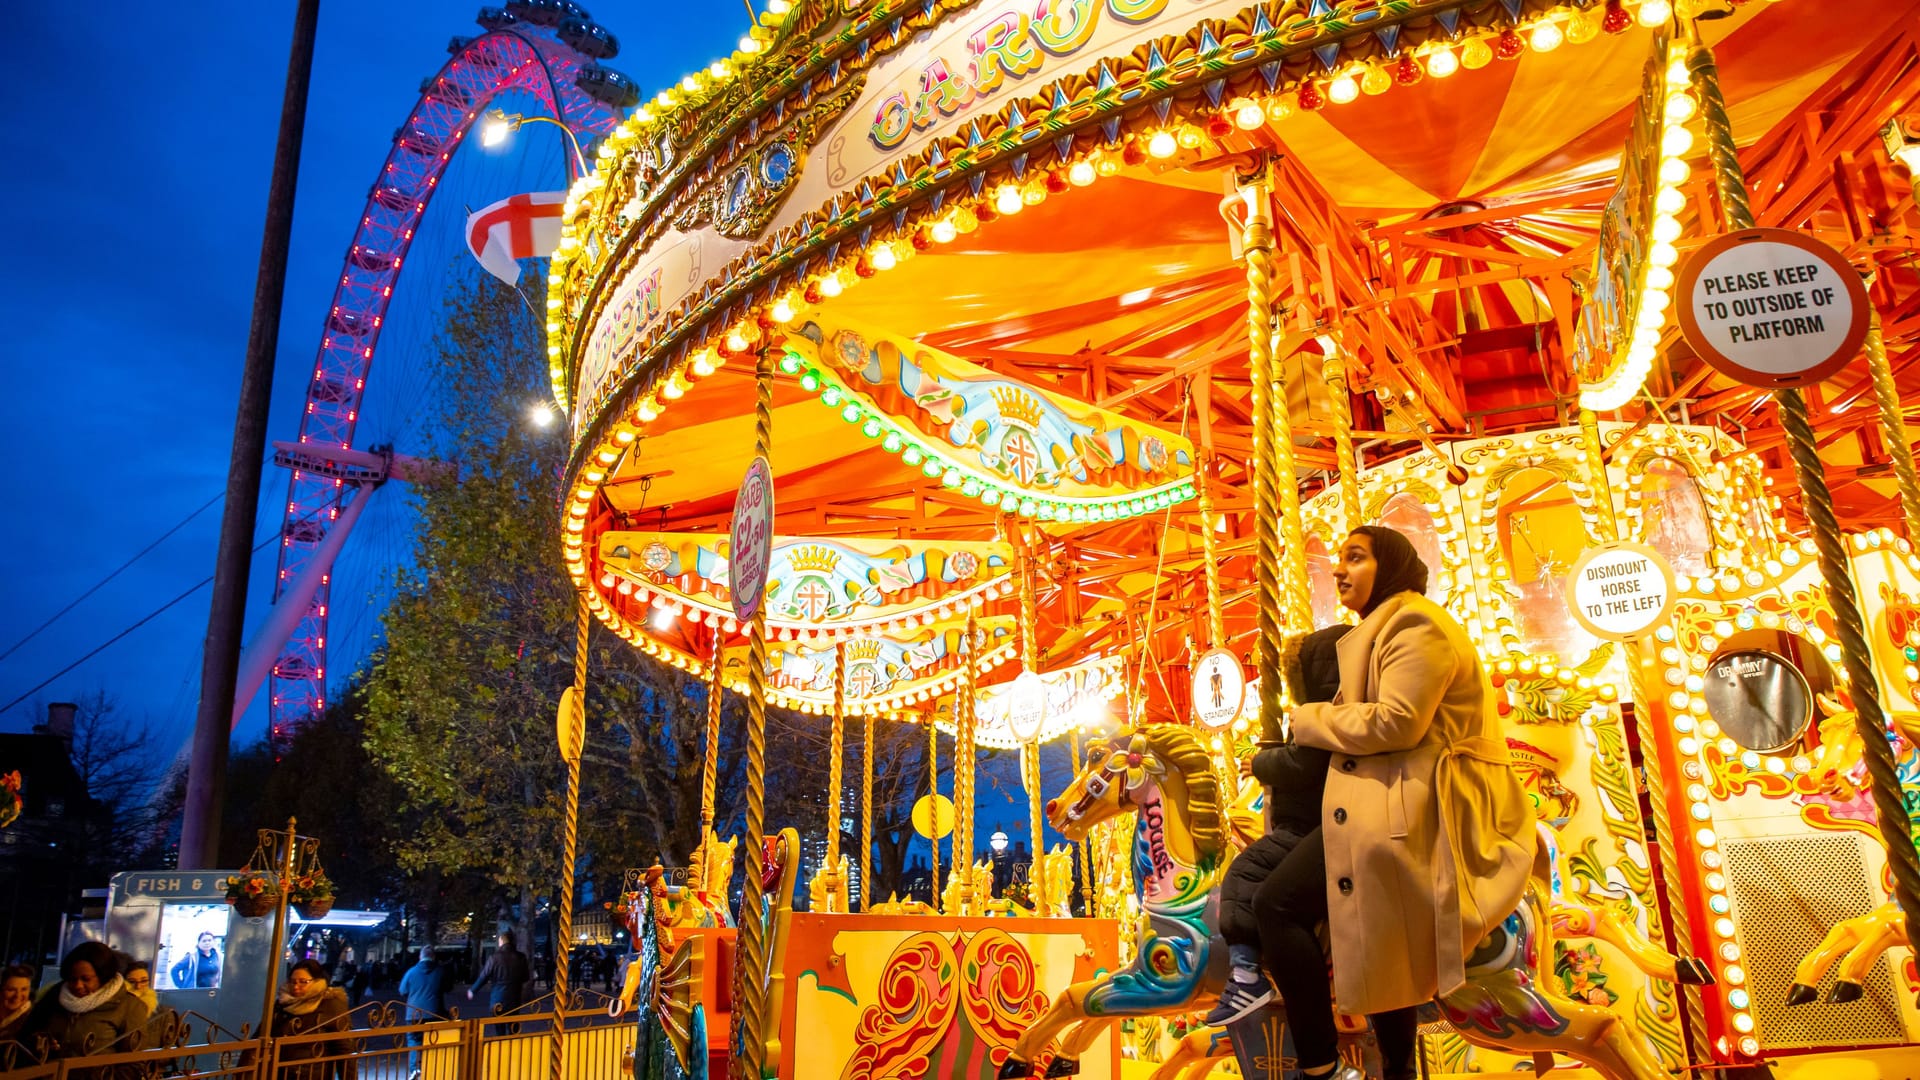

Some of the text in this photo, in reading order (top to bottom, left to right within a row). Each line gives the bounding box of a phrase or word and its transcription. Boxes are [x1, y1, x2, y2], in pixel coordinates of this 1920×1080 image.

[1703, 264, 1819, 296] PLEASE KEEP
[1704, 287, 1835, 320] TO OUTSIDE OF
[1729, 315, 1825, 343] PLATFORM
[740, 481, 763, 518] FARE
[741, 552, 758, 576] EACH
[1586, 560, 1647, 581] DISMOUNT
[738, 563, 761, 593] PERSON
[1601, 579, 1641, 597] HORSE
[1586, 595, 1662, 618] TO THE LEFT
[1210, 656, 1220, 666] NO
[1717, 660, 1762, 678] DRMMY
[1203, 706, 1235, 721] STANDING
[138, 878, 181, 891] FISH
[191, 878, 203, 890] &
